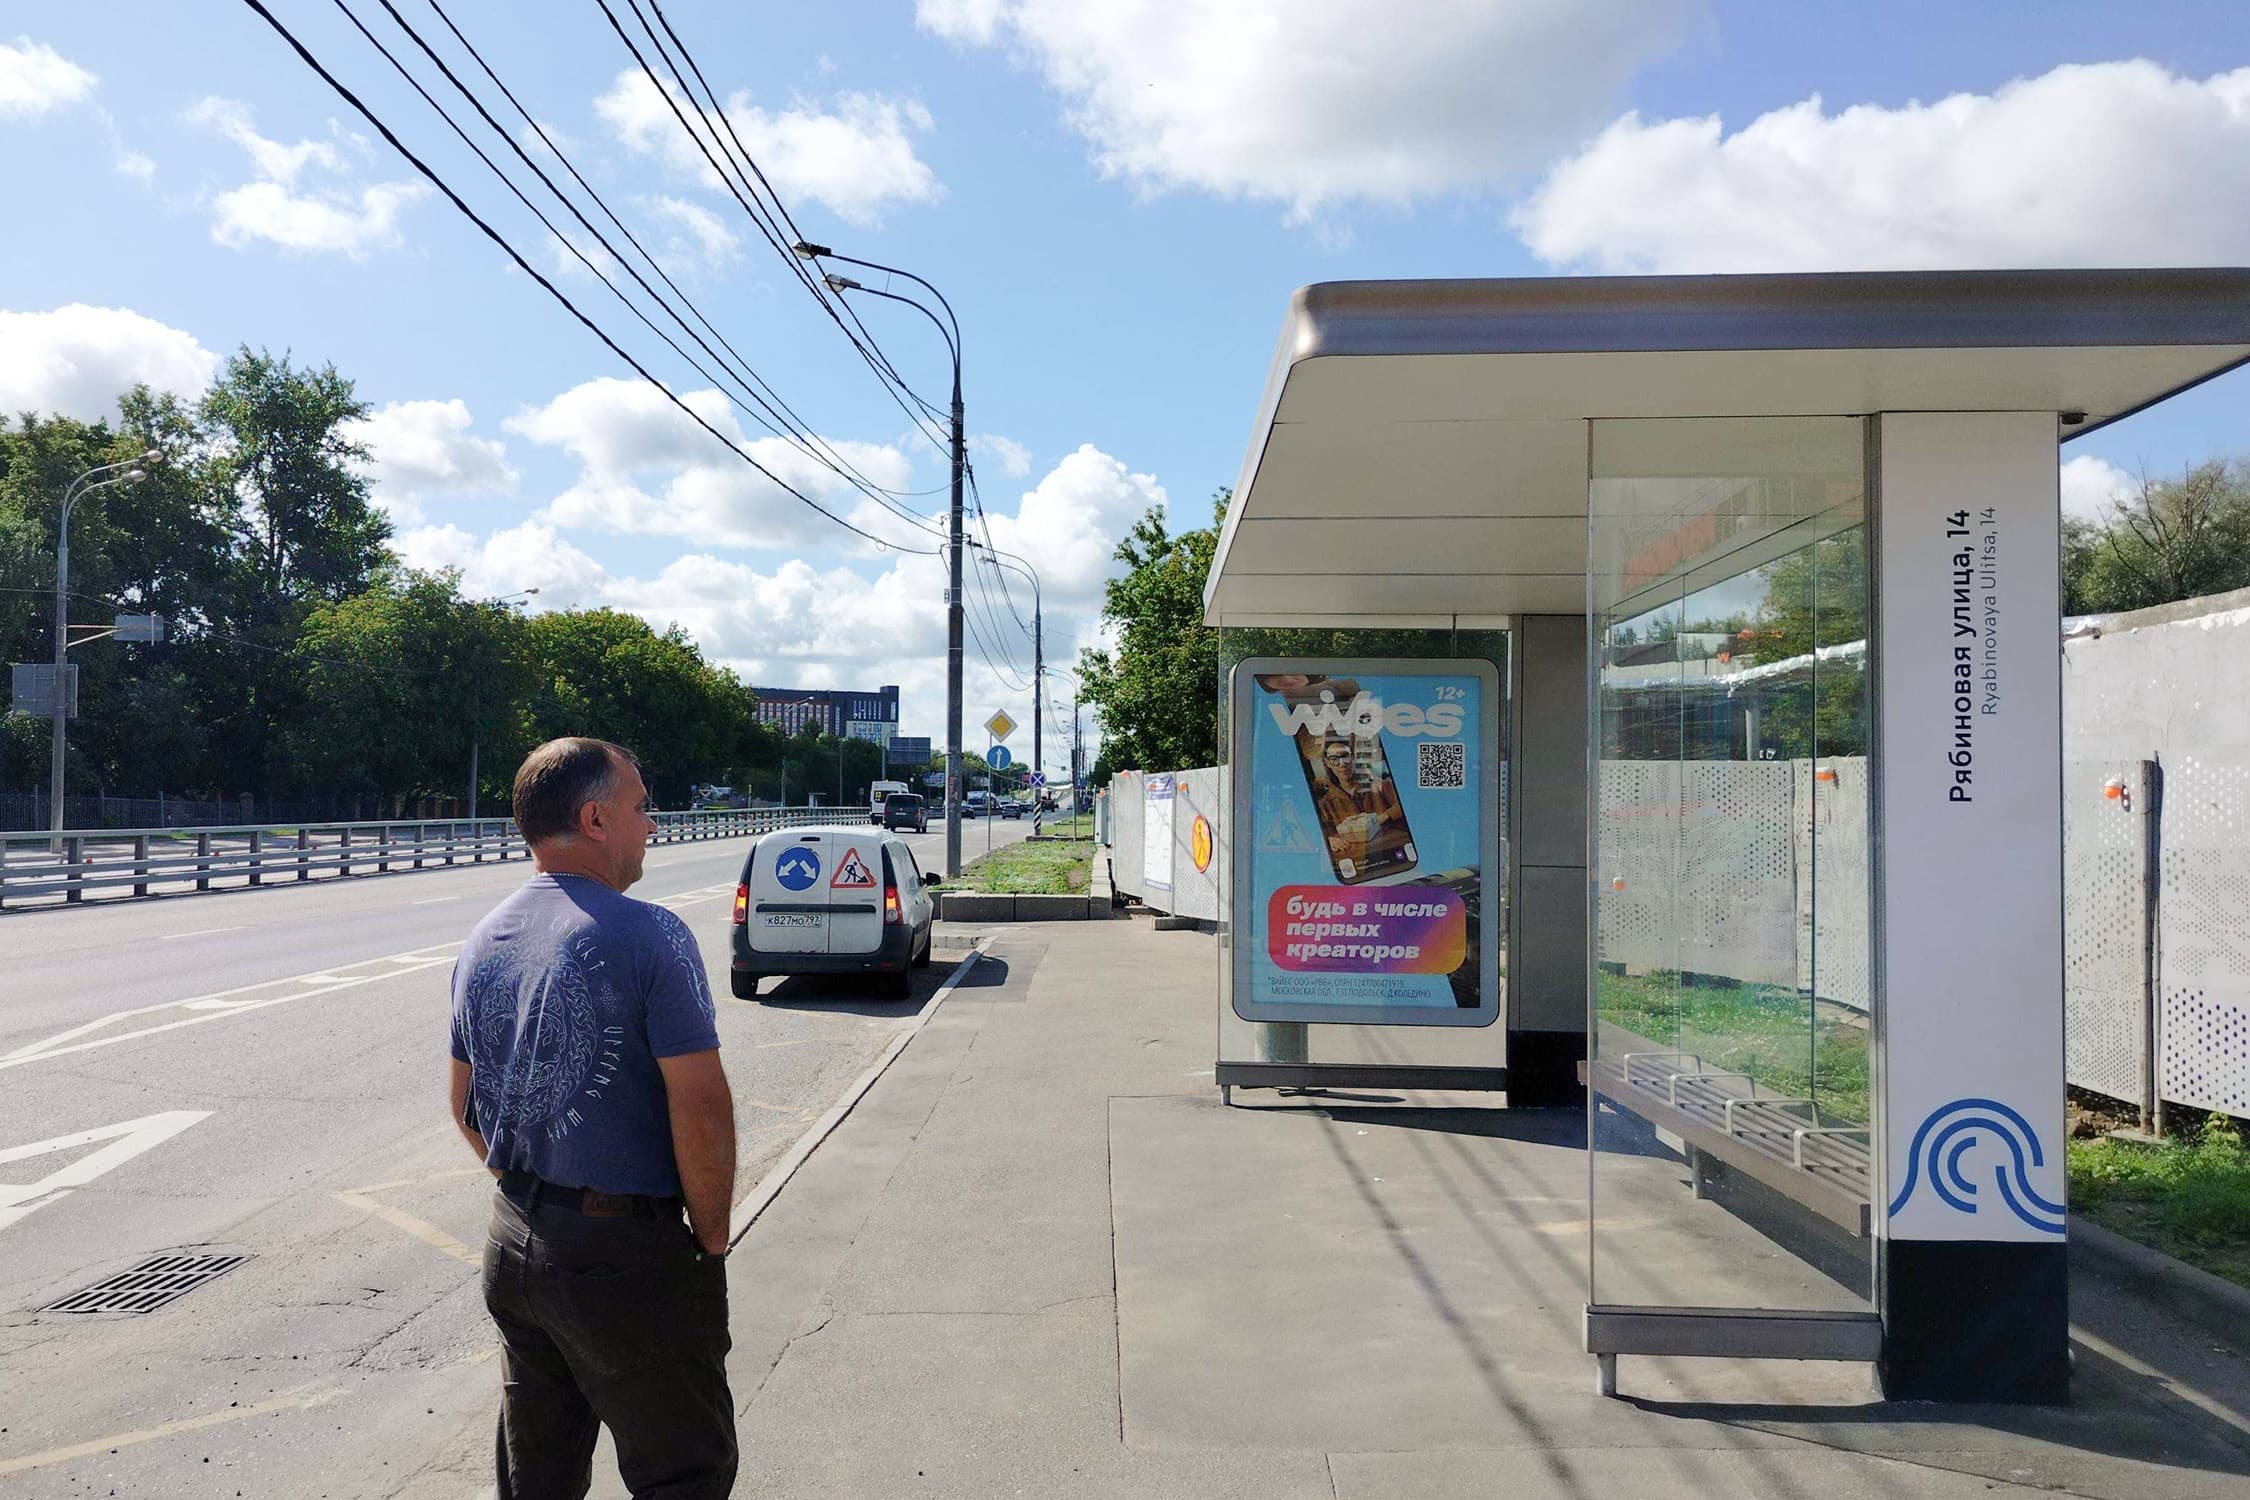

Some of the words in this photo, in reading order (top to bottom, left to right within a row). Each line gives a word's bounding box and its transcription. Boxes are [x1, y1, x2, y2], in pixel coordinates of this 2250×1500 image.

[1946, 509, 1971, 539] 14
[1979, 506, 1997, 527] 14
[1980, 530, 2000, 590] Ulitsa,
[1952, 545, 1977, 639] улица,
[1981, 595, 2001, 716] Ryabinovaya
[1436, 686, 1467, 700] 12+
[1948, 646, 1973, 803] Рябиновая
[1286, 895, 1346, 920] будь
[1352, 902, 1368, 916] в
[1374, 901, 1448, 918] числе
[1286, 920, 1382, 941] первых
[1286, 942, 1421, 963] креаторов
